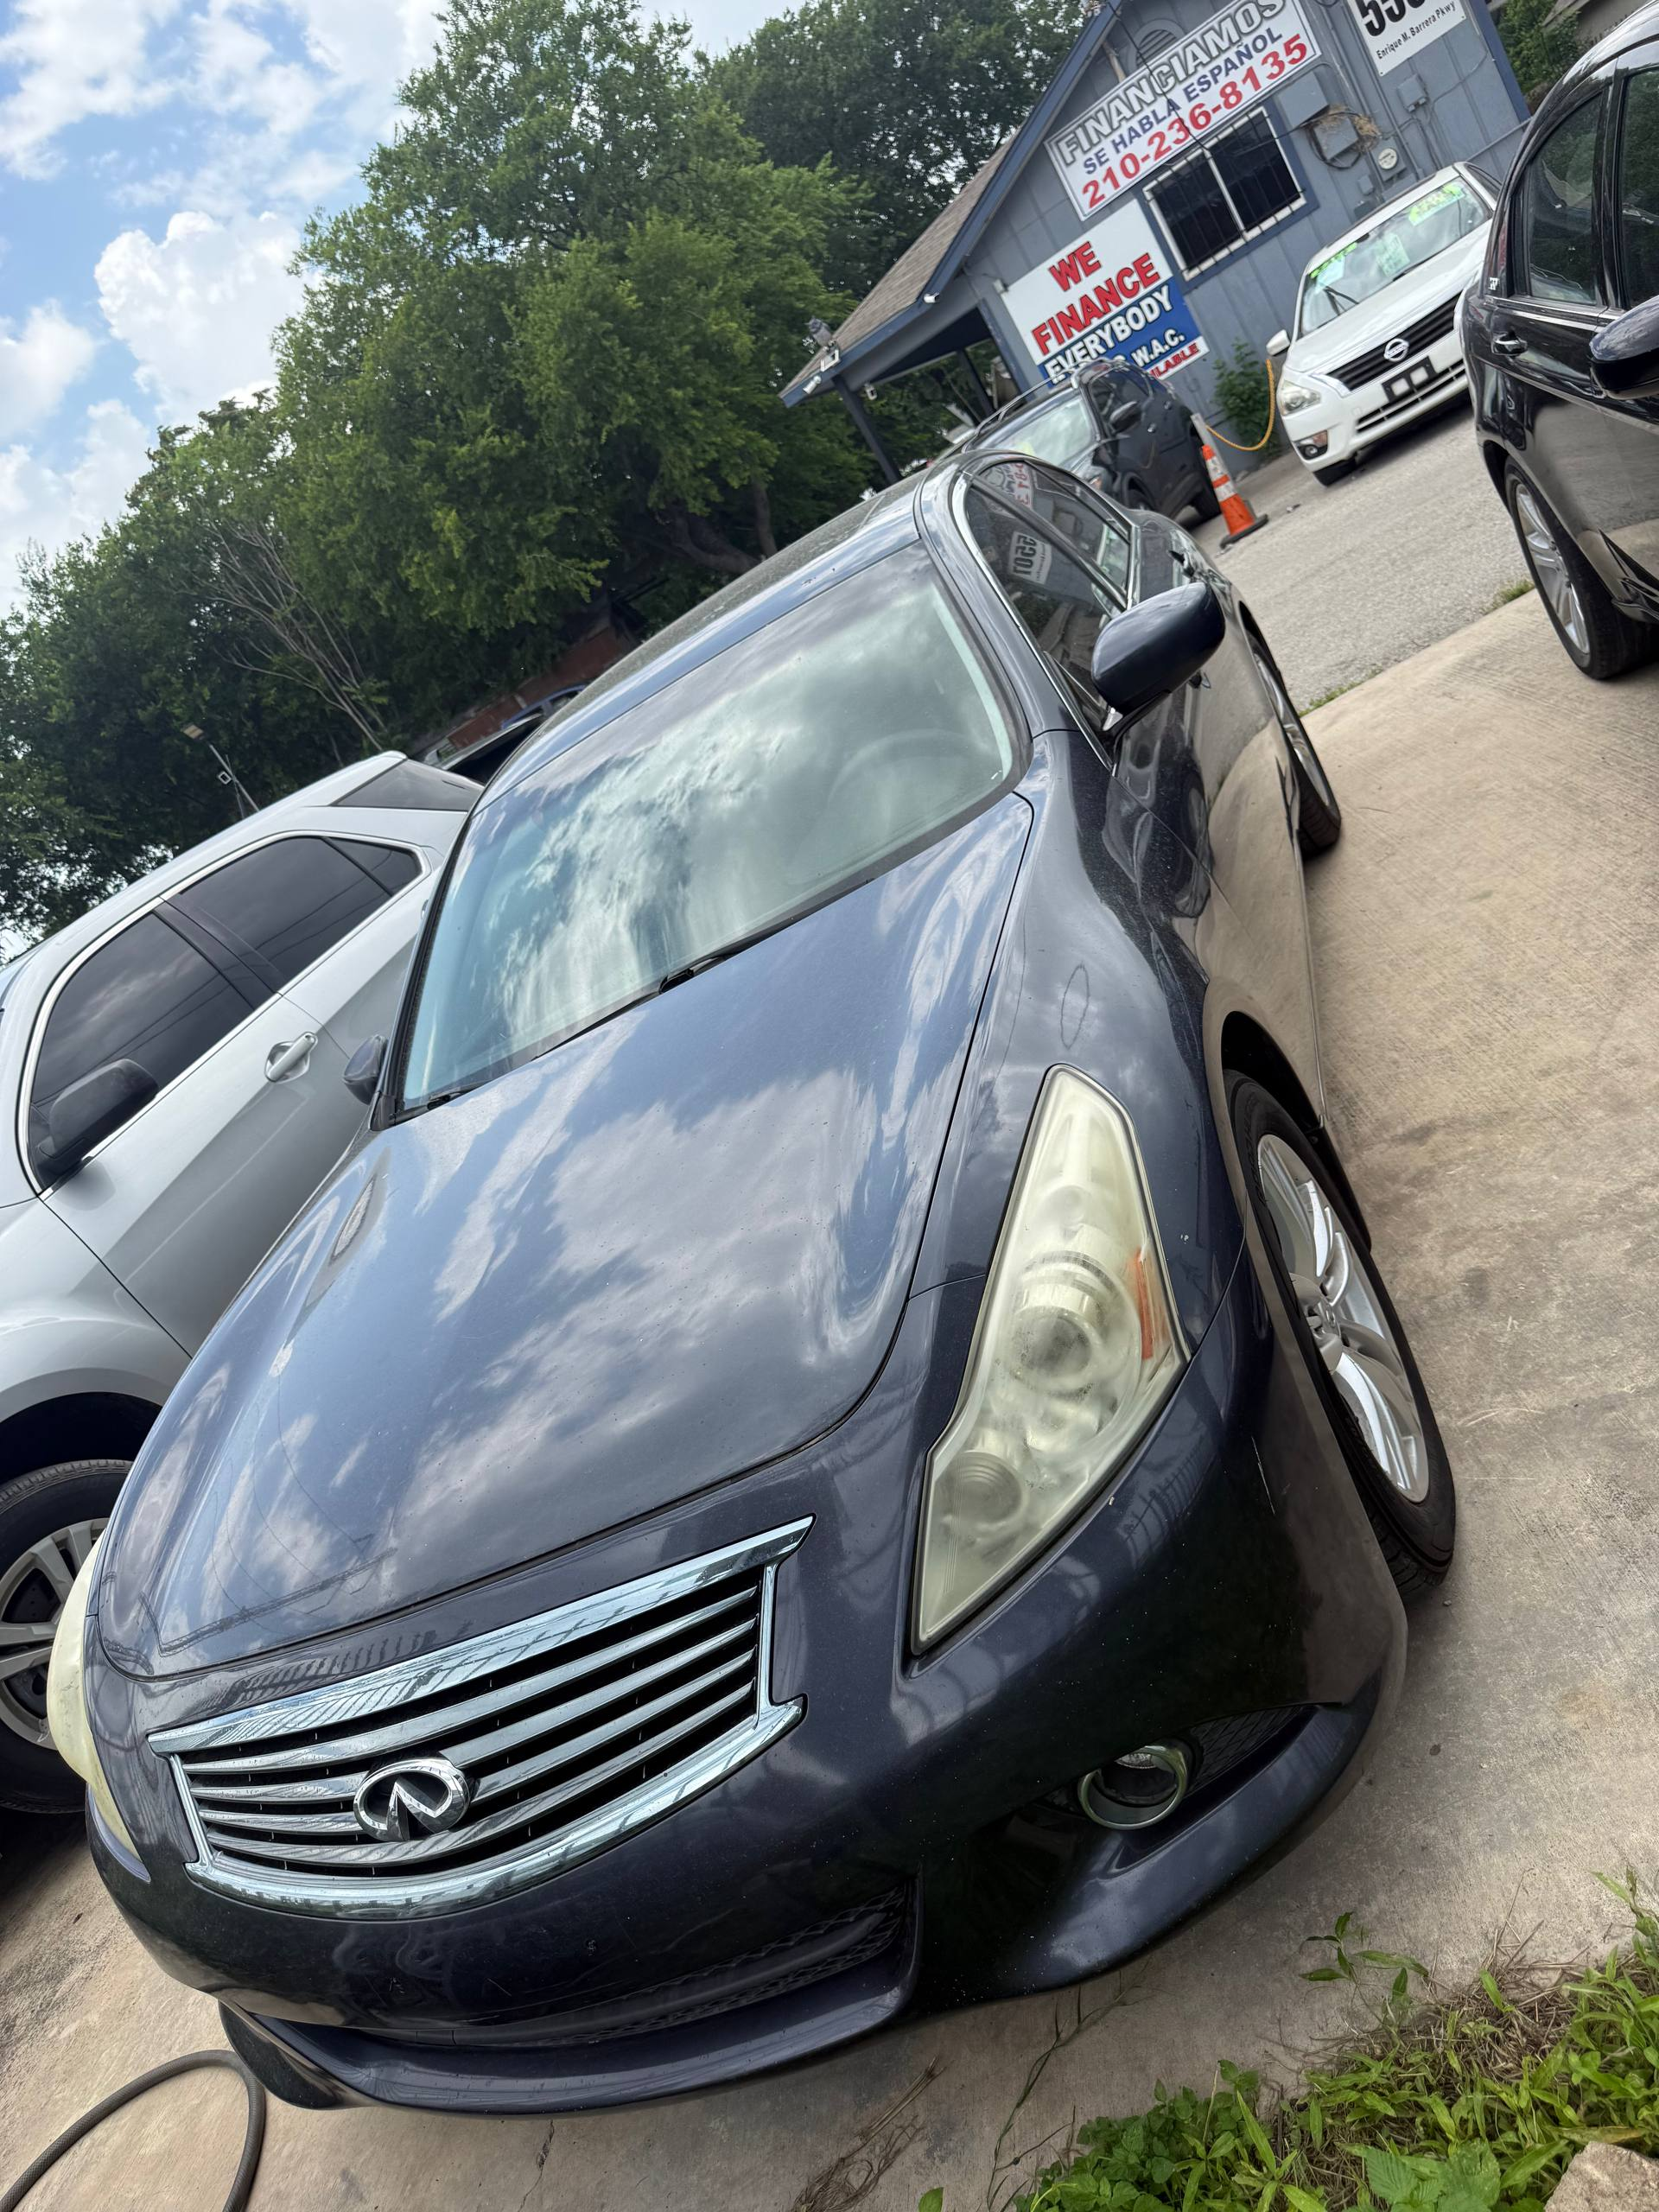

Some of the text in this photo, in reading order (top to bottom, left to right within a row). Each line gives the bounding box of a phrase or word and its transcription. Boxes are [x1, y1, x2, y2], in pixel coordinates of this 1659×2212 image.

[1356, 0, 1425, 36] 55
[1376, 2, 1456, 60] Enrique M. Barrera Pkwy
[1056, 0, 1285, 166] FINANCIAMOS
[1082, 34, 1307, 209] 210-236-8135
[1084, 28, 1283, 175] SE HABLA ESPAÑOL
[1032, 252, 1160, 356] FINANCE
[1048, 241, 1102, 292] WE
[1044, 285, 1173, 384] EVERYBODY
[1131, 328, 1185, 367] W.A.C.
